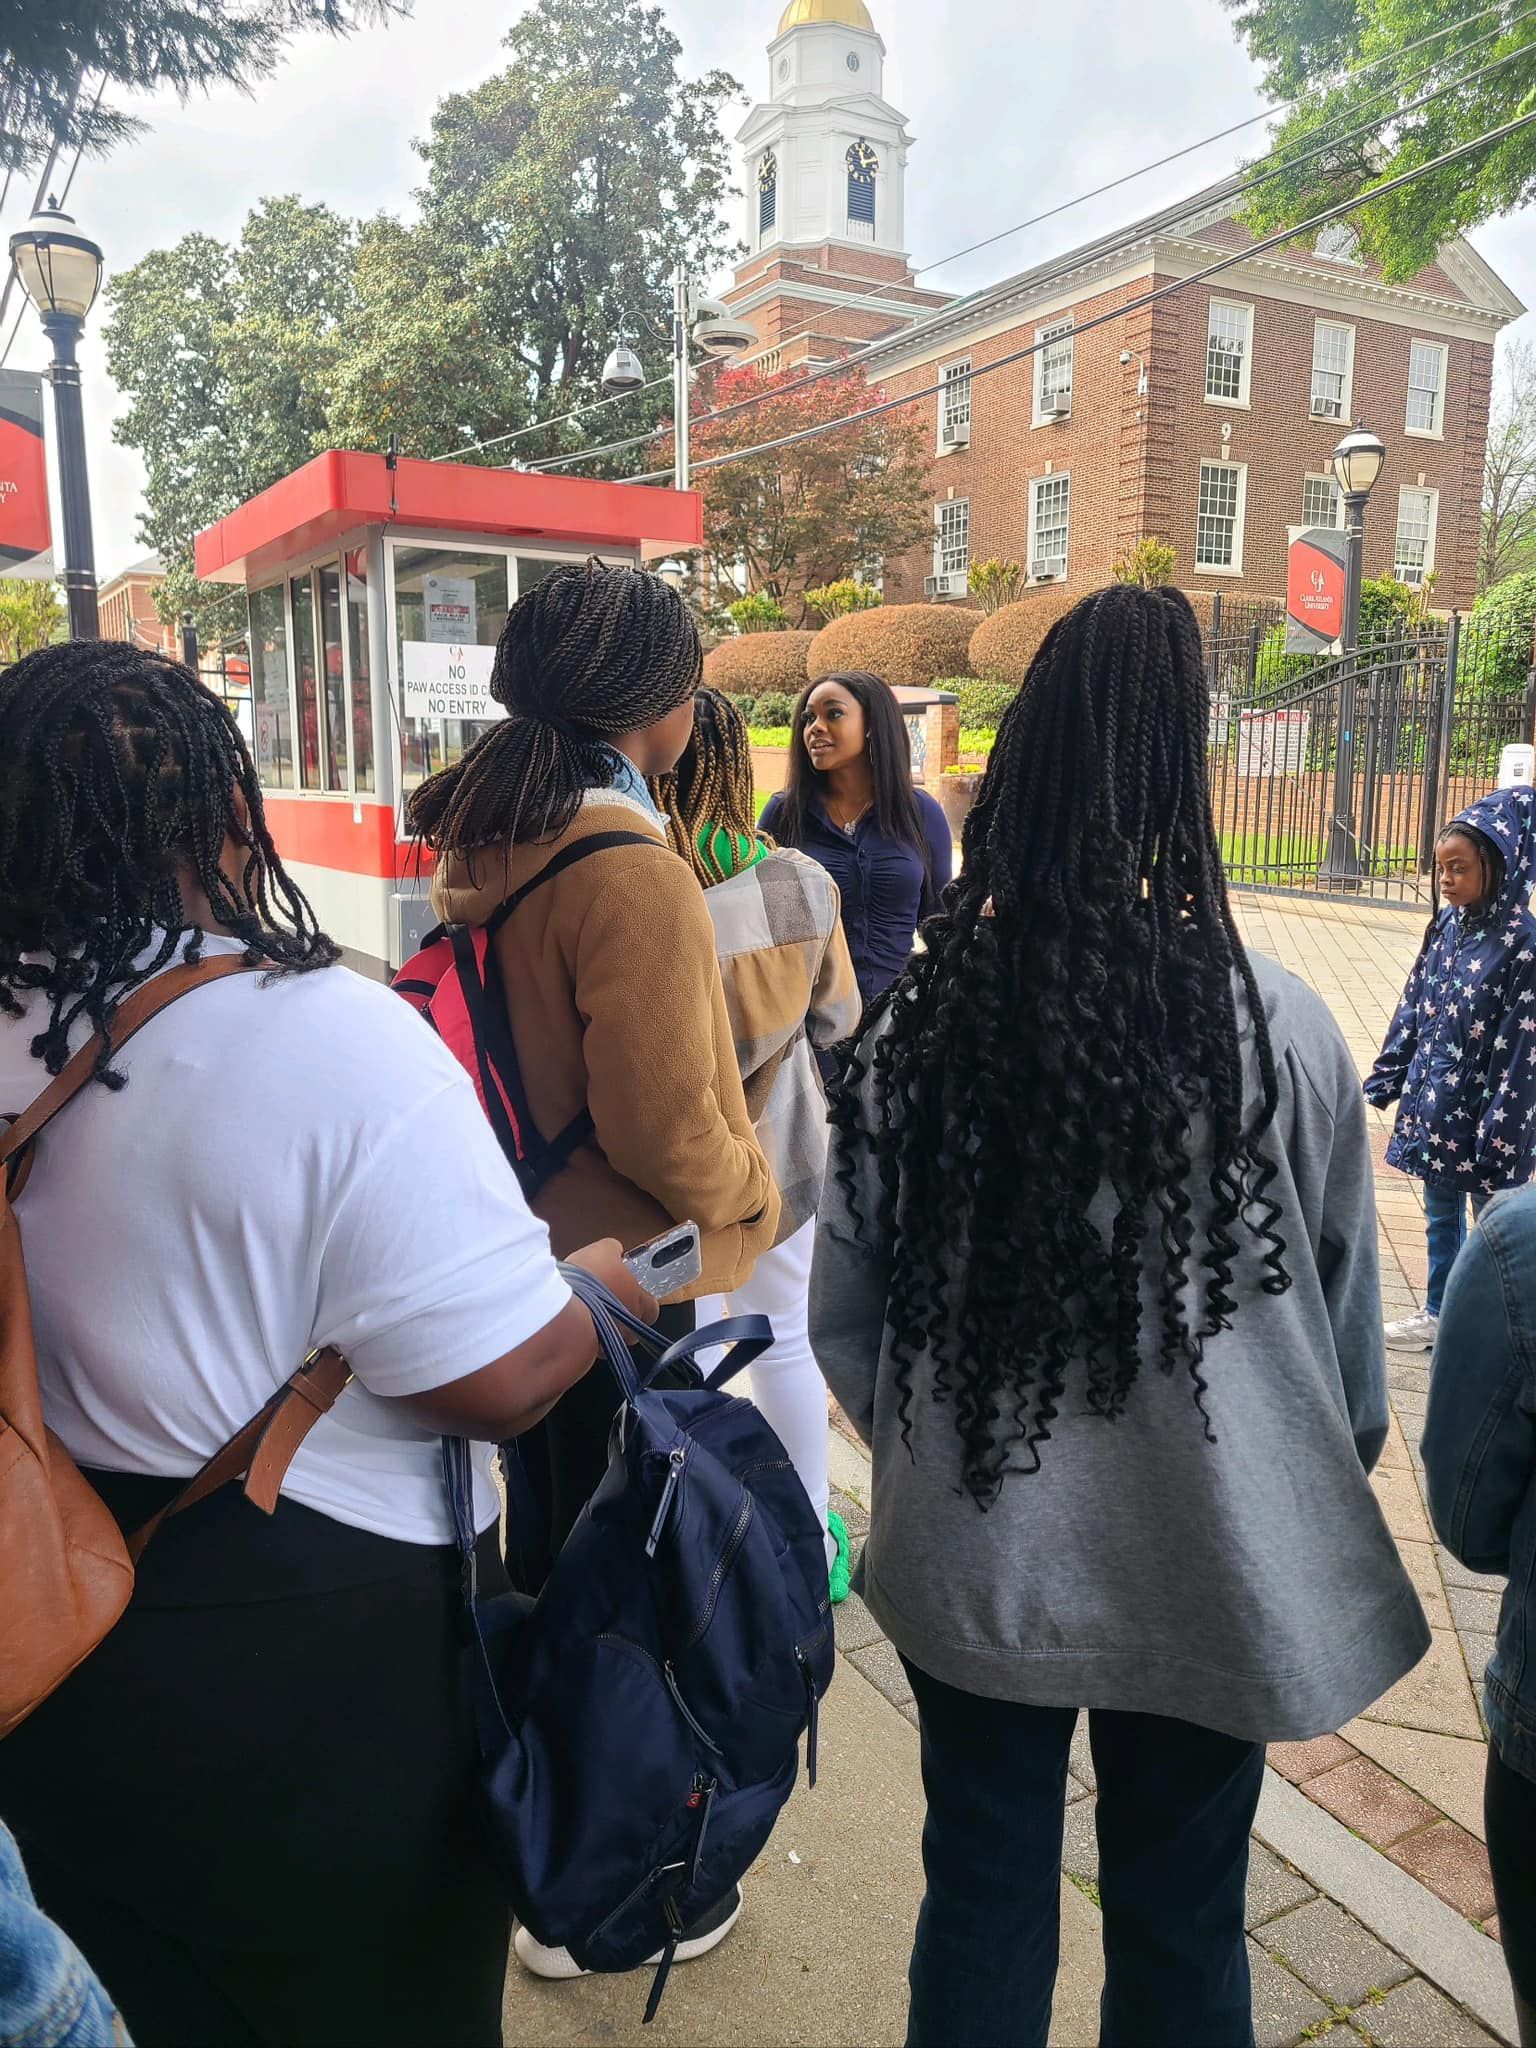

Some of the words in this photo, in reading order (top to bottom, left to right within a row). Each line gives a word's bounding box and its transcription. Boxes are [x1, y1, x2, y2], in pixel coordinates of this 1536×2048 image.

[448, 665, 466, 680] NO
[407, 681, 428, 693] PAW
[429, 682, 467, 695] ACCESS
[469, 684, 479, 696] ID
[481, 685, 490, 696] C
[428, 699, 446, 713] NO
[449, 700, 487, 715] ENTRY
